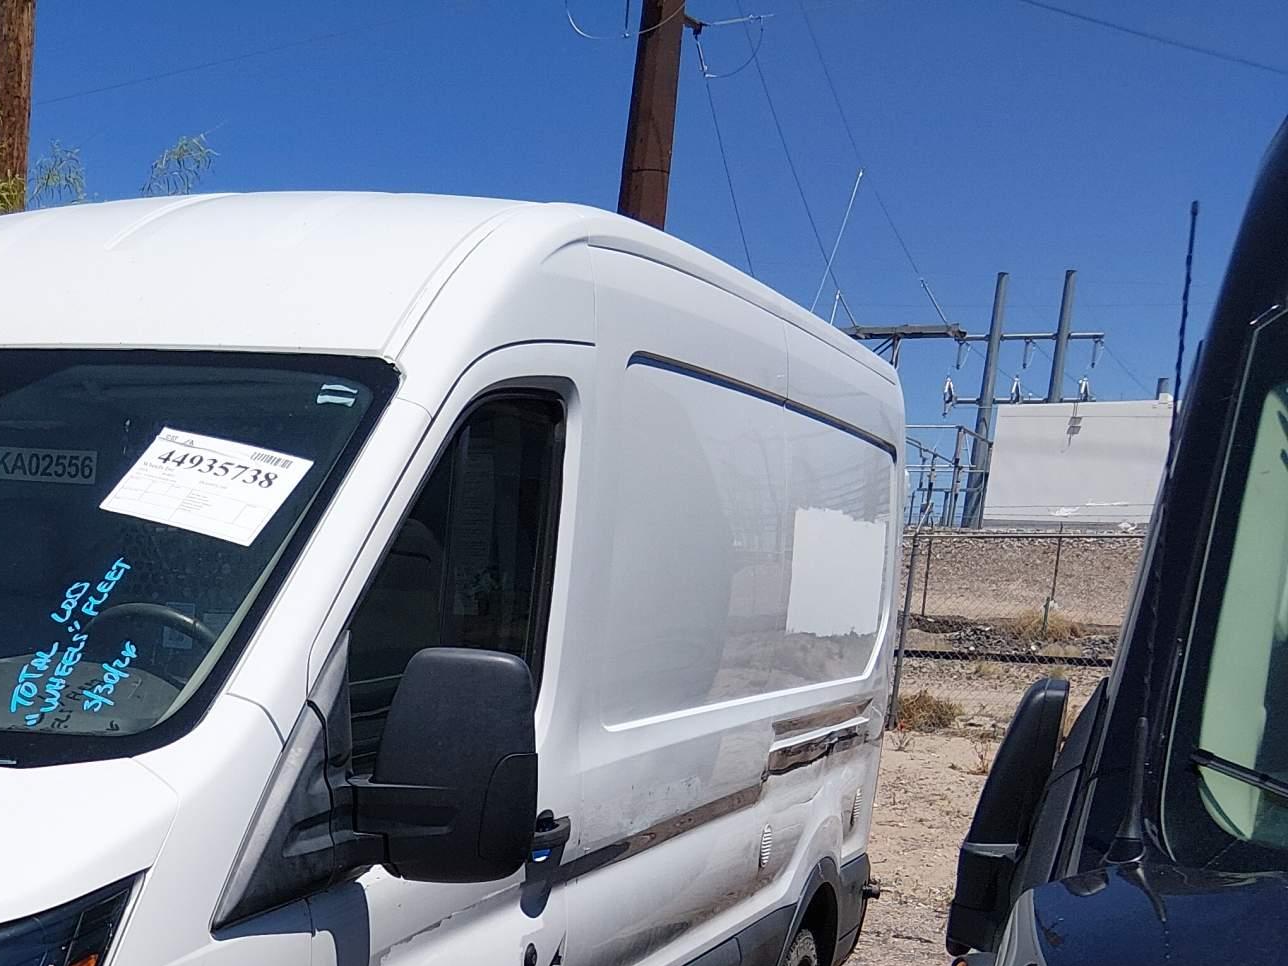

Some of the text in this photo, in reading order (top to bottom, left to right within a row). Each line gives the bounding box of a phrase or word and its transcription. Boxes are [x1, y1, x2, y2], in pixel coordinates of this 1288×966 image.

[157, 449, 279, 489] 44935738
[81, 557, 132, 617] FLEET
[10, 640, 60, 714] TOTAL
